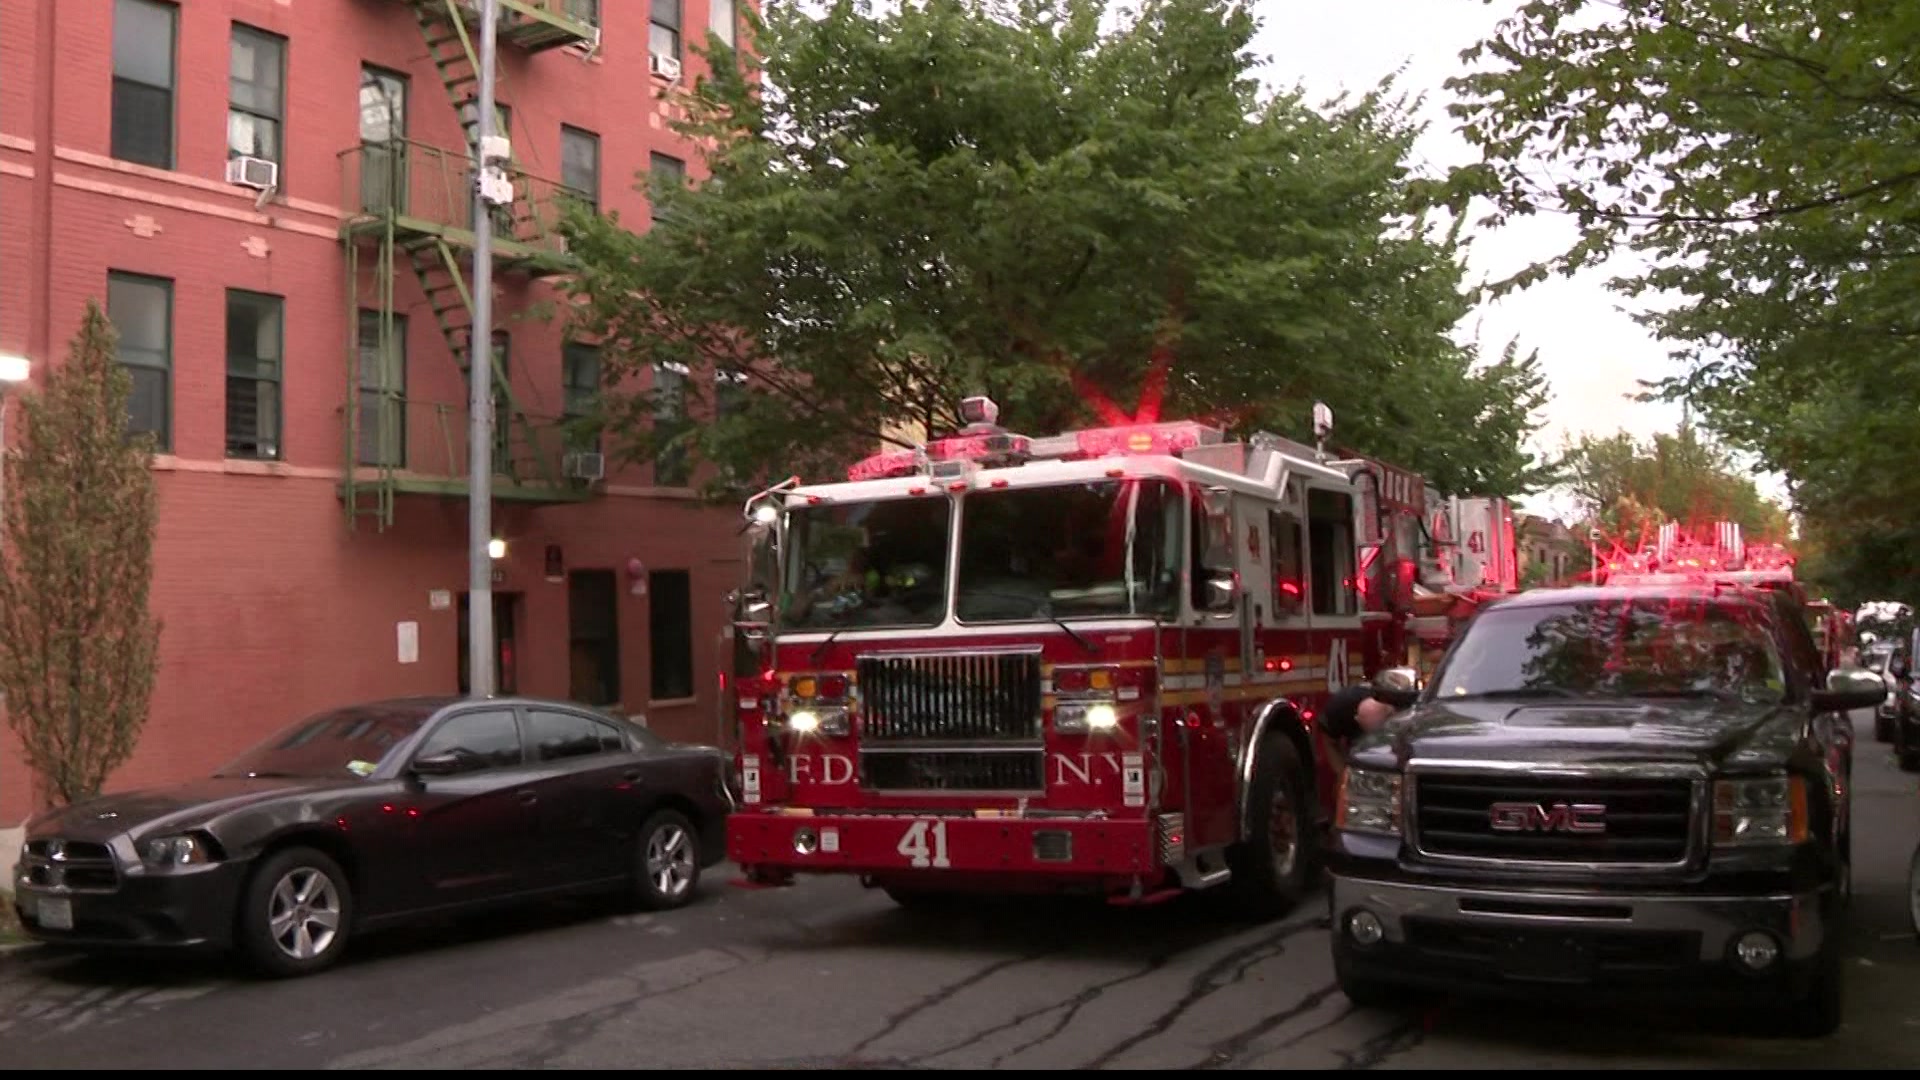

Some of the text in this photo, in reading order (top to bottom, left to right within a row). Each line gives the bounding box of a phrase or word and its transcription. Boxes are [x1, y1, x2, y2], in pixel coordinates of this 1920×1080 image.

[1468, 531, 1484, 553] 41
[789, 754, 859, 785] F.D.
[1490, 802, 1606, 833] GMC
[897, 820, 951, 868] 41
